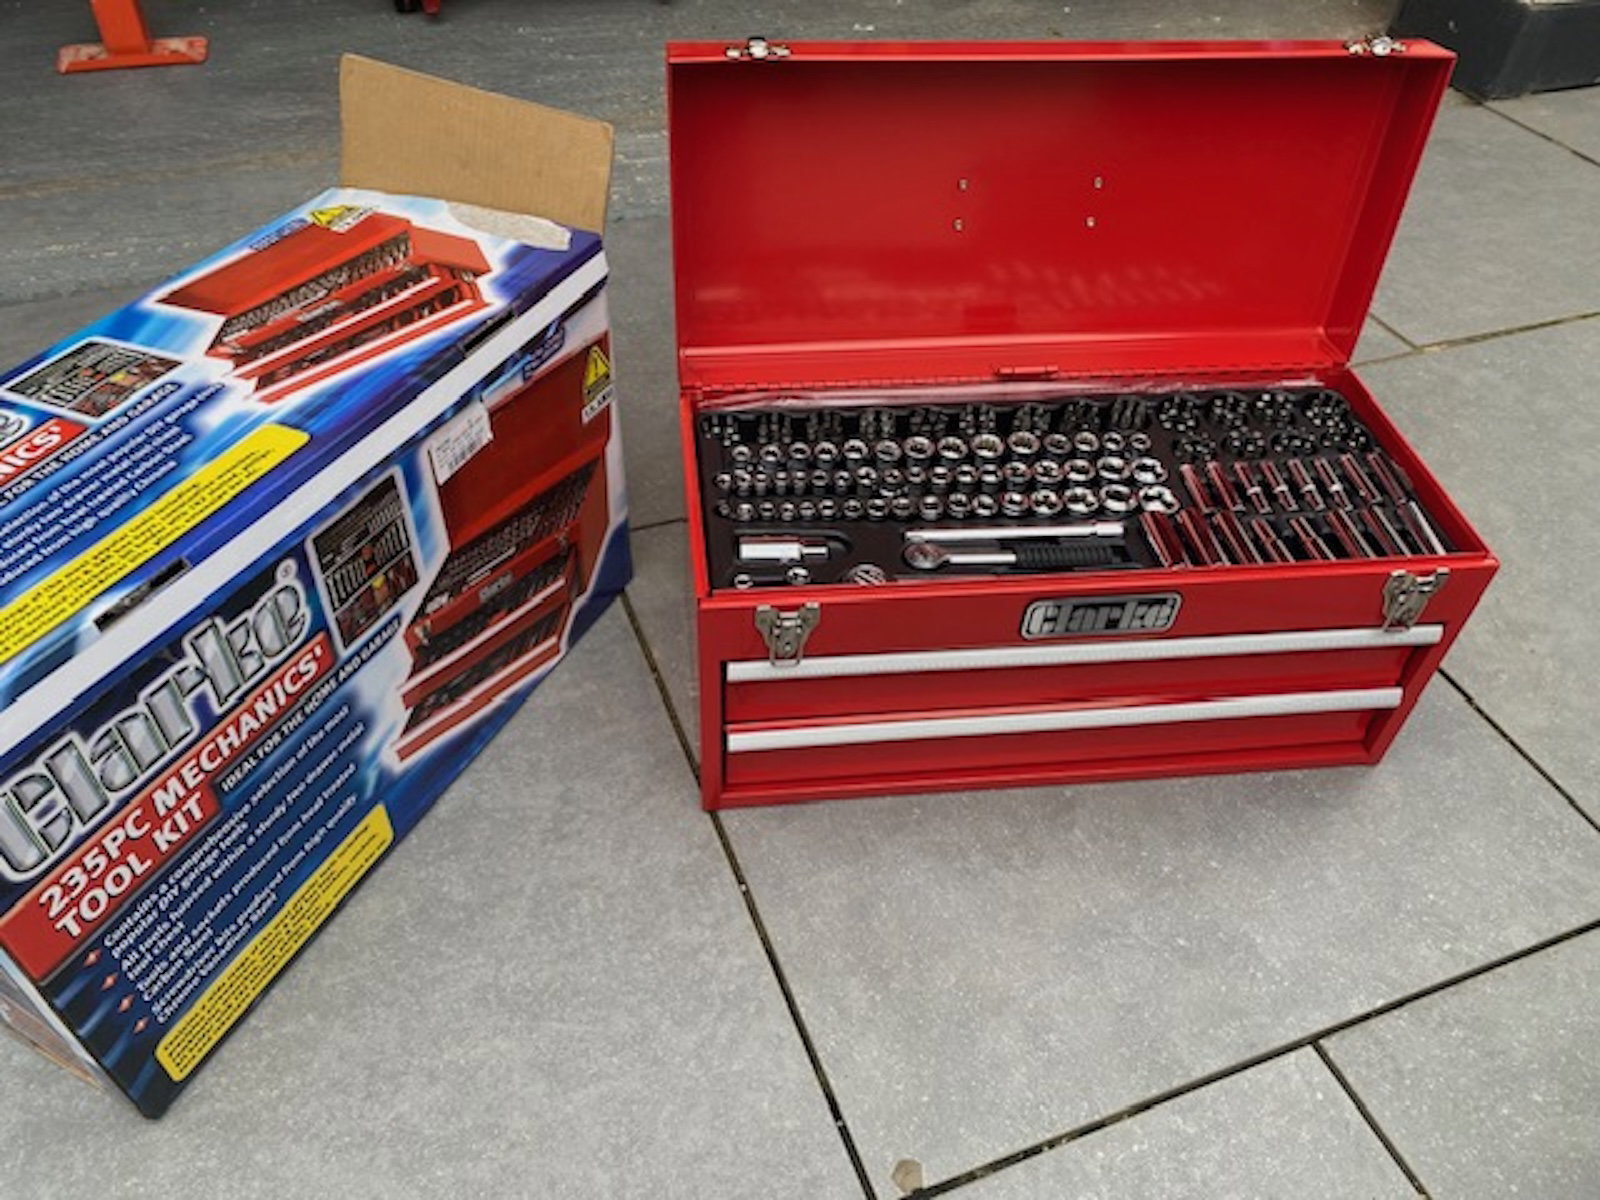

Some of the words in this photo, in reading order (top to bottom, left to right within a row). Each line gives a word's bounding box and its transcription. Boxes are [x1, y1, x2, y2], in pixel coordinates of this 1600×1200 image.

[2, 473, 38, 502] FOR
[29, 455, 65, 484] THE
[57, 431, 103, 465] HOME
[99, 413, 129, 437] AND
[126, 379, 179, 418] GARAGE
[46, 488, 62, 504] of
[58, 476, 81, 495] the
[78, 457, 108, 480] most
[31, 522, 63, 544] from
[60, 504, 89, 526] heat
[39, 533, 72, 557] from
[68, 515, 100, 538] high
[1029, 600, 1172, 634] Clarke
[220, 755, 257, 792] IDEAL
[254, 730, 284, 759] FOR
[278, 710, 306, 736] THE
[301, 675, 339, 715] HOME
[335, 653, 363, 681] AND
[358, 618, 402, 660] GARAGE
[38, 809, 152, 919] 235PC
[150, 646, 323, 818] MECHANICS'
[101, 890, 160, 948] Contains
[156, 881, 170, 895] a
[166, 802, 252, 886] comprehensive
[247, 756, 298, 806] selection
[294, 744, 308, 759] of
[304, 727, 325, 749] the
[322, 703, 350, 732] most
[116, 948, 138, 972] All
[136, 917, 172, 953] tools
[166, 874, 214, 922] housed
[209, 841, 248, 880] within
[244, 834, 257, 846] a
[253, 800, 290, 838] sturdy
[283, 781, 307, 806] two
[302, 748, 339, 785] drawer
[337, 720, 366, 752] metal
[54, 848, 152, 940] TOOL
[151, 789, 203, 853] KIT
[109, 907, 161, 959] popular
[156, 884, 182, 911] DIY
[178, 847, 221, 891] garage
[217, 818, 249, 851] tools
[135, 957, 169, 992] Tools
[166, 933, 192, 962] and
[188, 890, 233, 938] sockets
[230, 841, 280, 896] produced
[276, 819, 302, 848] from
[297, 795, 325, 824] heat
[320, 761, 358, 800] treated
[150, 944, 217, 1015] Screwdriver
[212, 920, 239, 946] bits
[279, 848, 306, 877] from
[301, 825, 329, 853] high
[325, 791, 360, 830] quality
[125, 951, 154, 981] tool
[149, 919, 186, 956] chest
[140, 955, 185, 1003] Carbon
[180, 925, 215, 960] Steel
[154, 974, 202, 1024] Chrome
[196, 920, 252, 978] Vanadium
[247, 891, 279, 924] Steel
